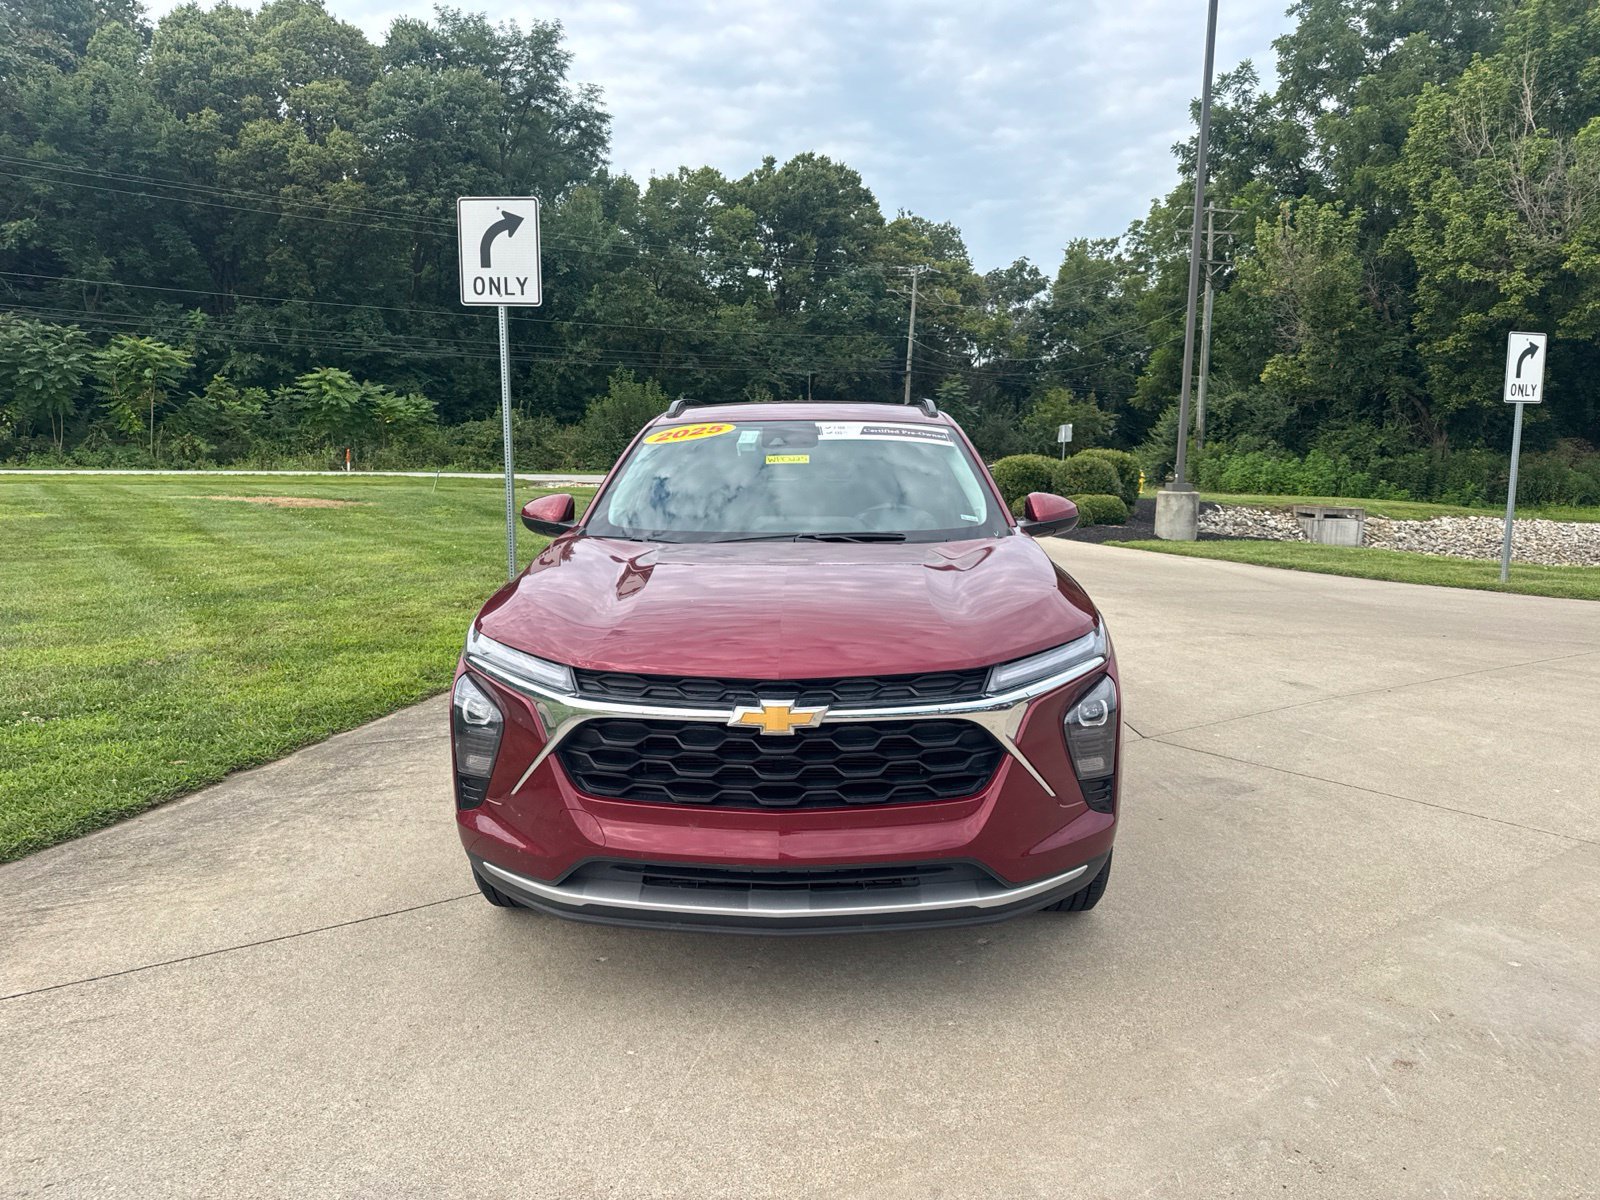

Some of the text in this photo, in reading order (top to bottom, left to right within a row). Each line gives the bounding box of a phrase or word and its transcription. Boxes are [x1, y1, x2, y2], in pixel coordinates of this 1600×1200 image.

[473, 276, 528, 296] ONLY
[1510, 383, 1537, 397] ONLY
[654, 425, 725, 443] 2025
[901, 430, 947, 439] Pre-Owned
